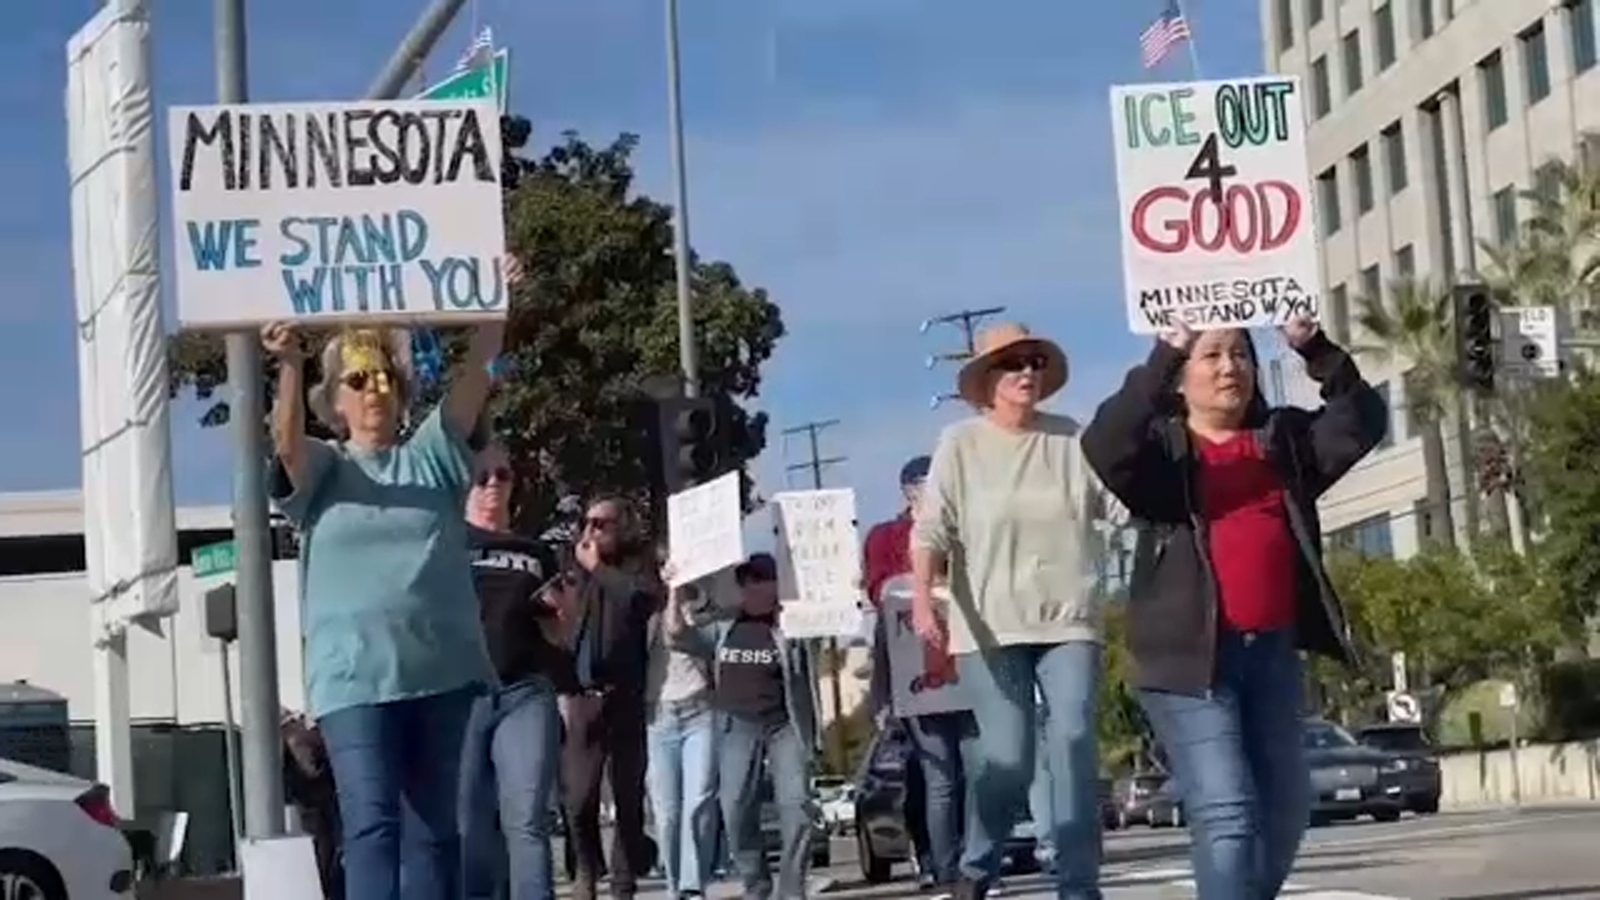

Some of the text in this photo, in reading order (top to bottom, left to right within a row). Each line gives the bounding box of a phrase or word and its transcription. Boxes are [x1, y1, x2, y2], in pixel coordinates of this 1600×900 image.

[1123, 82, 1294, 149] ICE OUT
[179, 108, 497, 191] MINNESOTA
[1184, 131, 1237, 204] 4
[186, 209, 428, 271] WE STAND
[1131, 180, 1301, 254] GOOD
[282, 255, 501, 314] WITH YOU
[1140, 278, 1303, 308] MINNESOTA
[1145, 308, 1177, 328] WE
[1183, 300, 1256, 324] STAND
